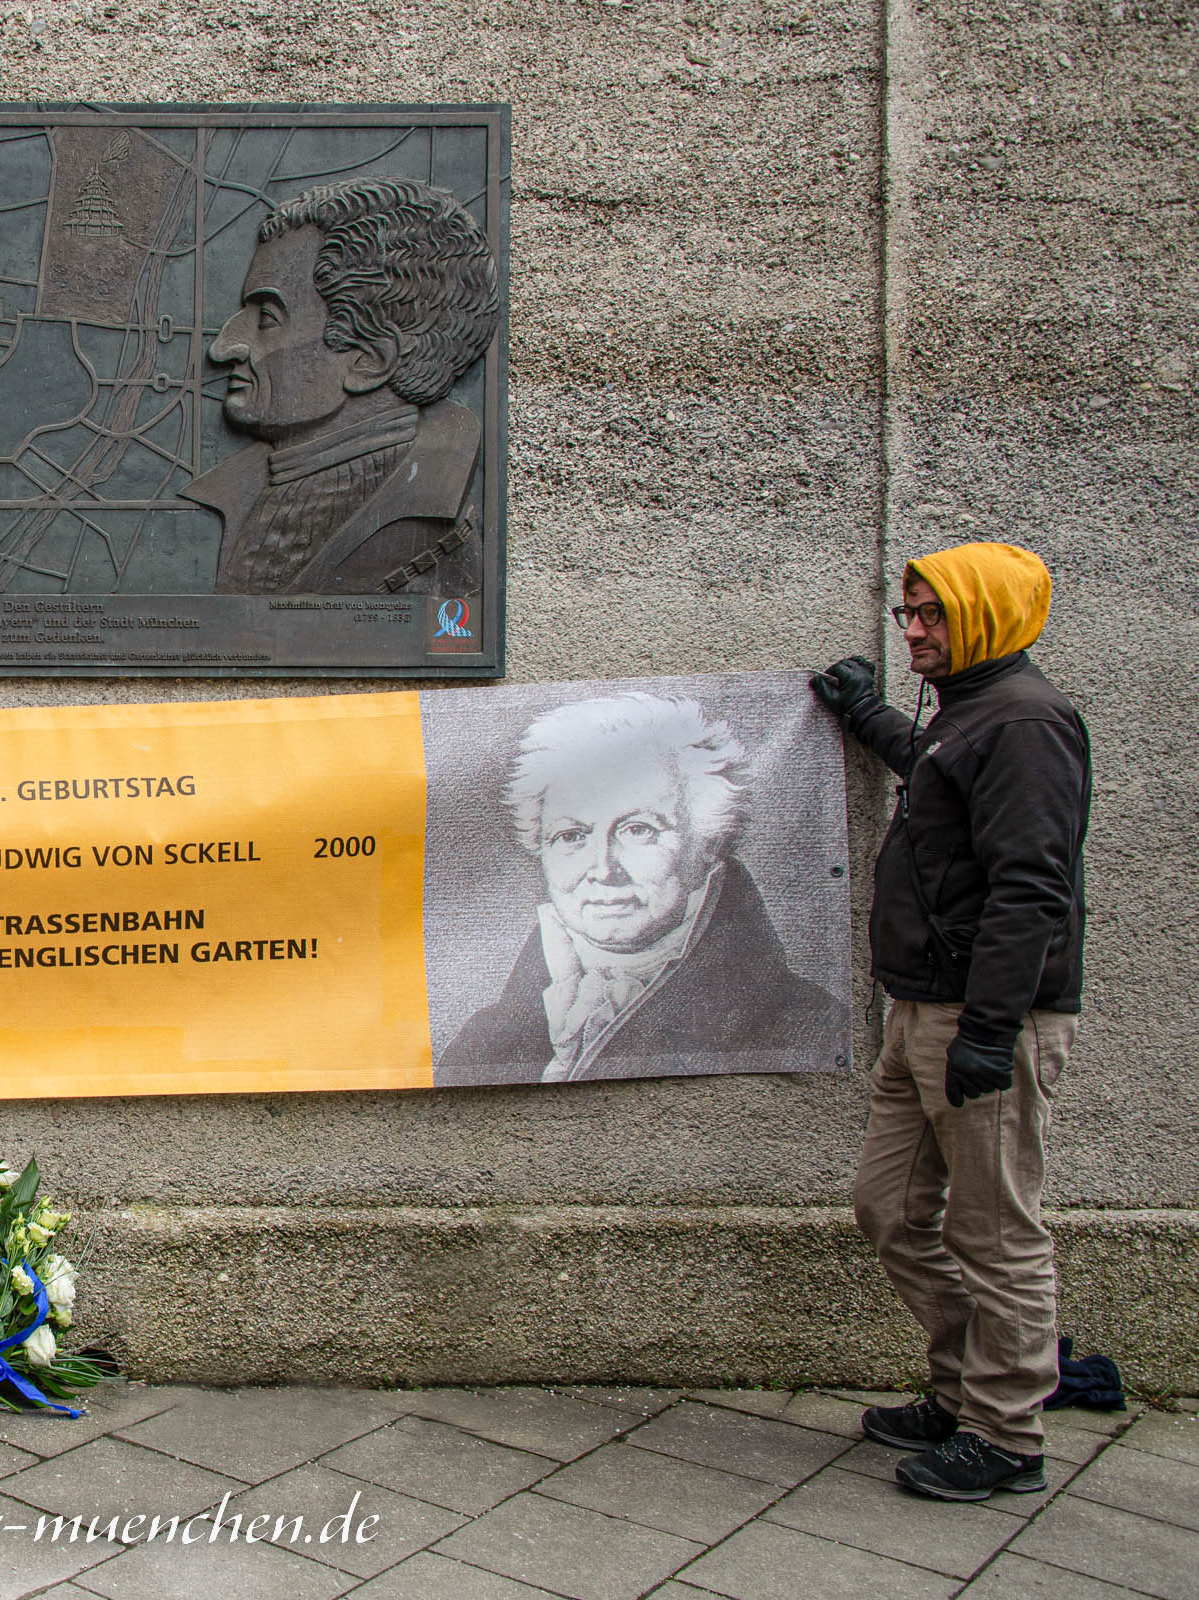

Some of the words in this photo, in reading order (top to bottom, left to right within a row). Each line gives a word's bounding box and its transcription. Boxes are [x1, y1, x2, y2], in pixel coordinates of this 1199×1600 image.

[3, 601, 31, 613] Den
[34, 600, 105, 613] Gestaltern
[269, 600, 322, 610] Maximilian
[323, 600, 344, 610] Graf
[345, 601, 363, 610] von
[43, 616, 70, 629] und
[73, 616, 98, 629] der
[100, 616, 135, 629] Stadt
[137, 615, 200, 629] München
[2, 633, 32, 644] zum
[34, 631, 106, 644] Gedenken.
[17, 775, 196, 801] GEBURTSTAG
[91, 844, 153, 867] VON
[164, 841, 261, 865] SCKELL
[313, 835, 376, 859] 2000
[190, 938, 318, 963] GARTEN!
